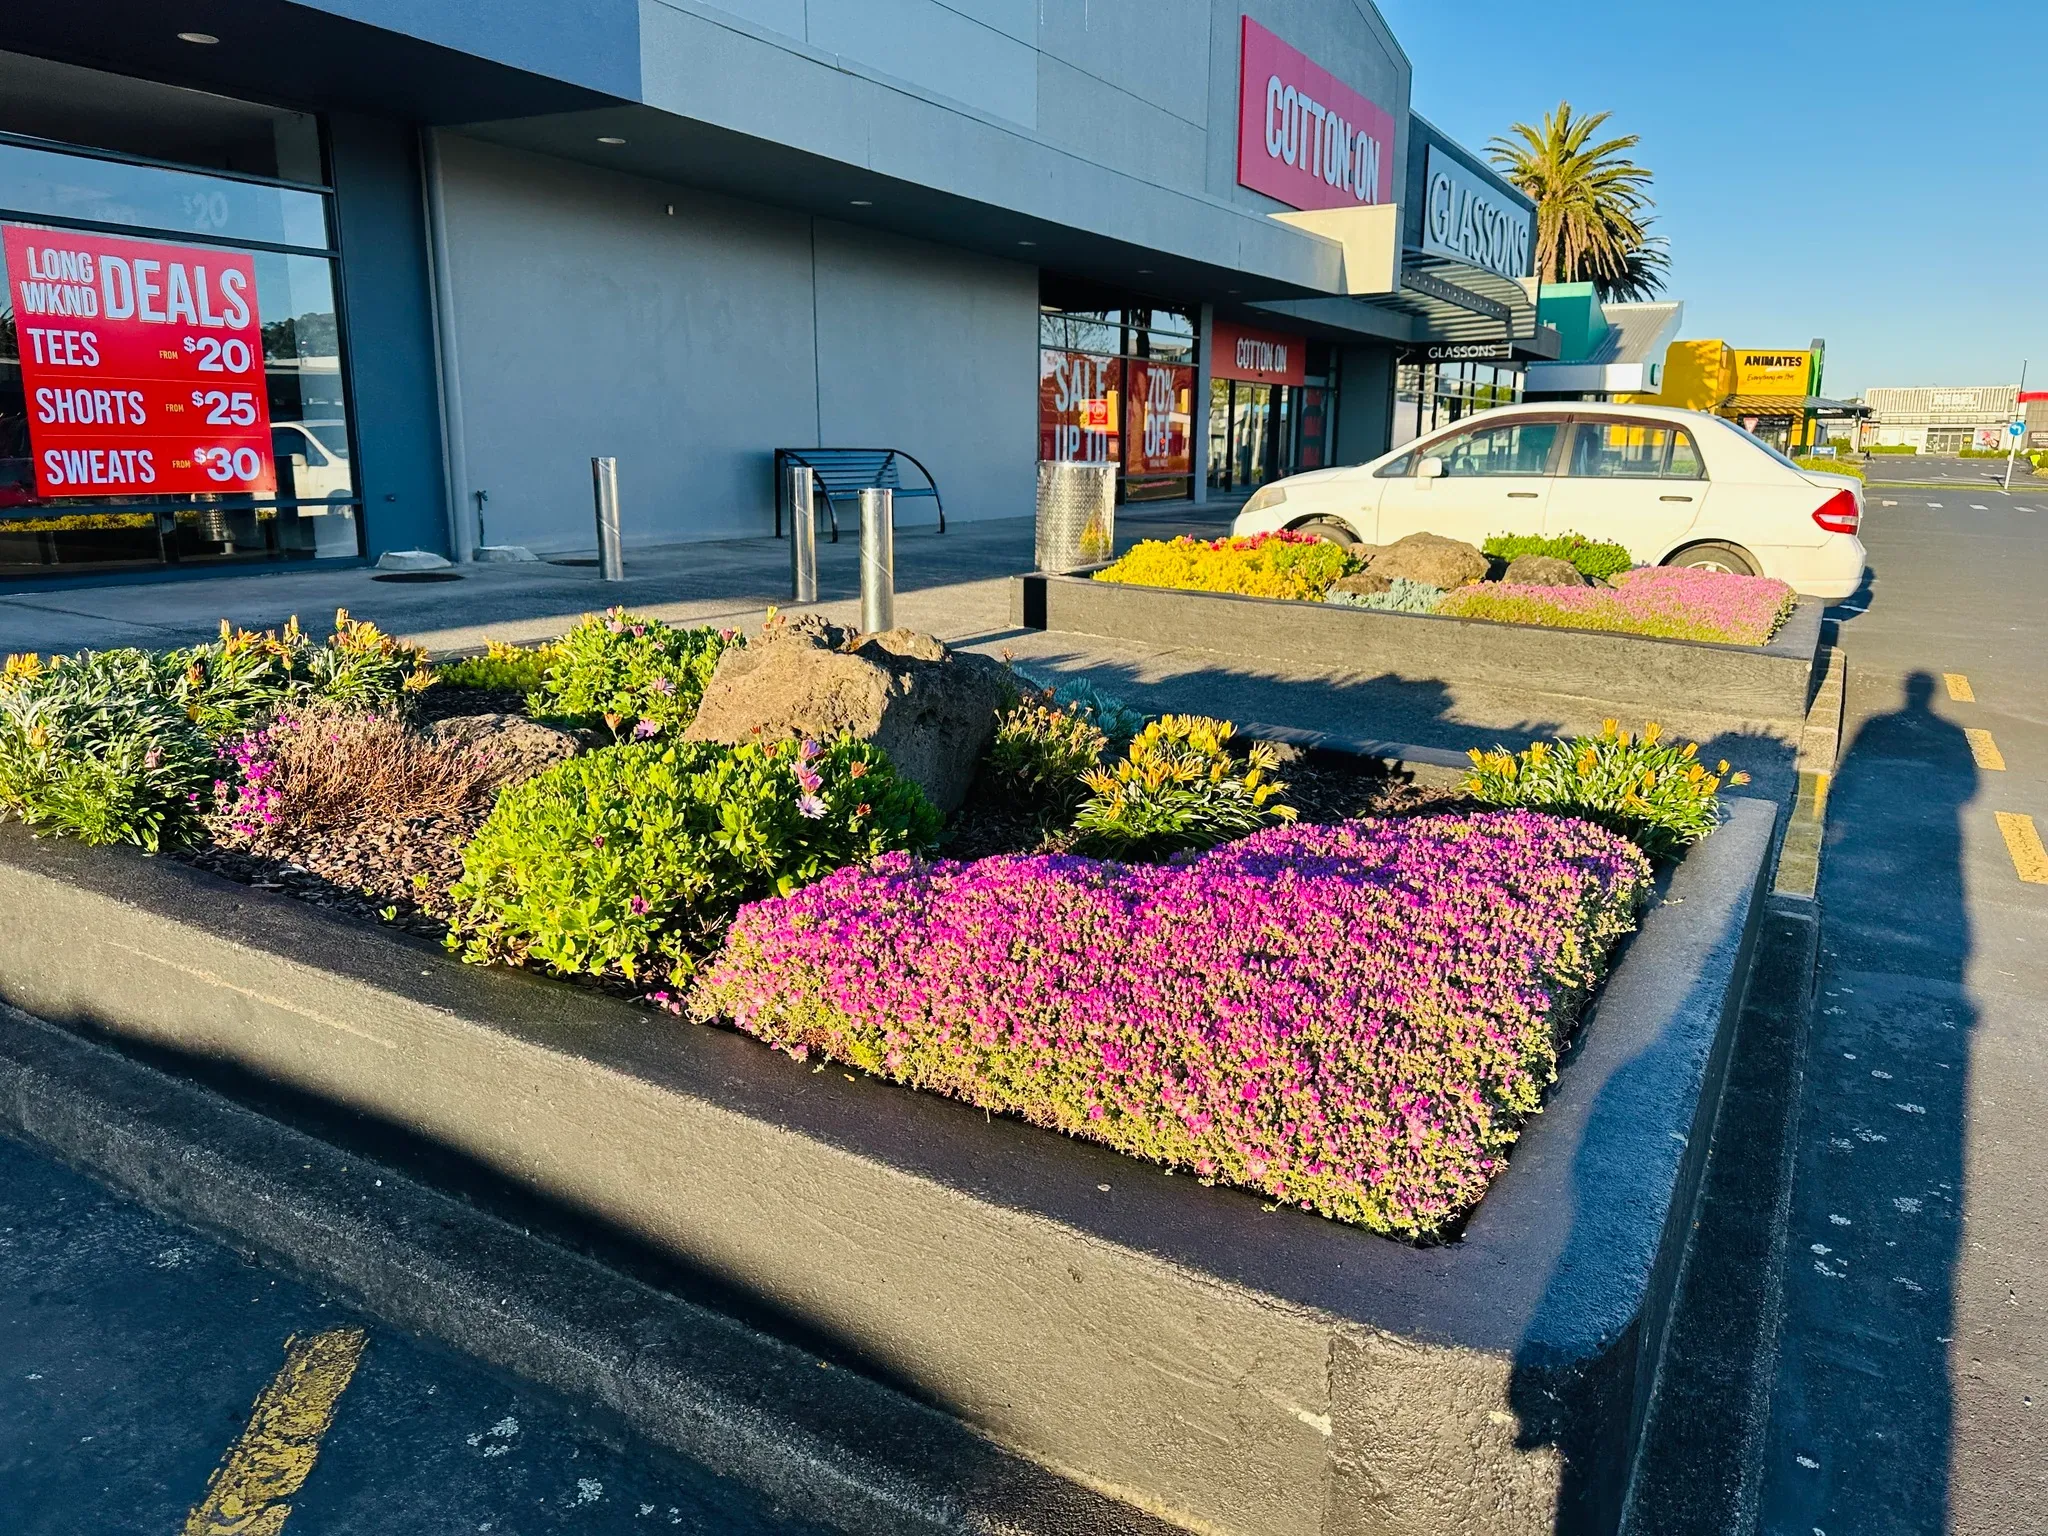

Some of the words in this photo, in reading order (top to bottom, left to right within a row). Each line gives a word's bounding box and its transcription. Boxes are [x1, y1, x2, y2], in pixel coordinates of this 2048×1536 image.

[1430, 172, 1527, 277] GLASSONS
[26, 247, 94, 284] LONG
[20, 281, 98, 318] WKND
[98, 255, 250, 331] DEALS
[26, 328, 100, 367] TEES
[159, 350, 178, 360] FROM
[183, 336, 251, 373] $20
[1428, 344, 1497, 359] GLASSONS
[1744, 355, 1802, 367] ANIMATES
[1055, 354, 1108, 413] SALE
[1147, 367, 1176, 412] 70%
[35, 387, 147, 425] SHORTS
[165, 403, 185, 413] FROM
[191, 390, 256, 426] $25
[1145, 413, 1173, 458] OFF
[44, 449, 156, 485] SWEATS
[172, 460, 191, 469] FROM
[194, 447, 260, 482] $30
